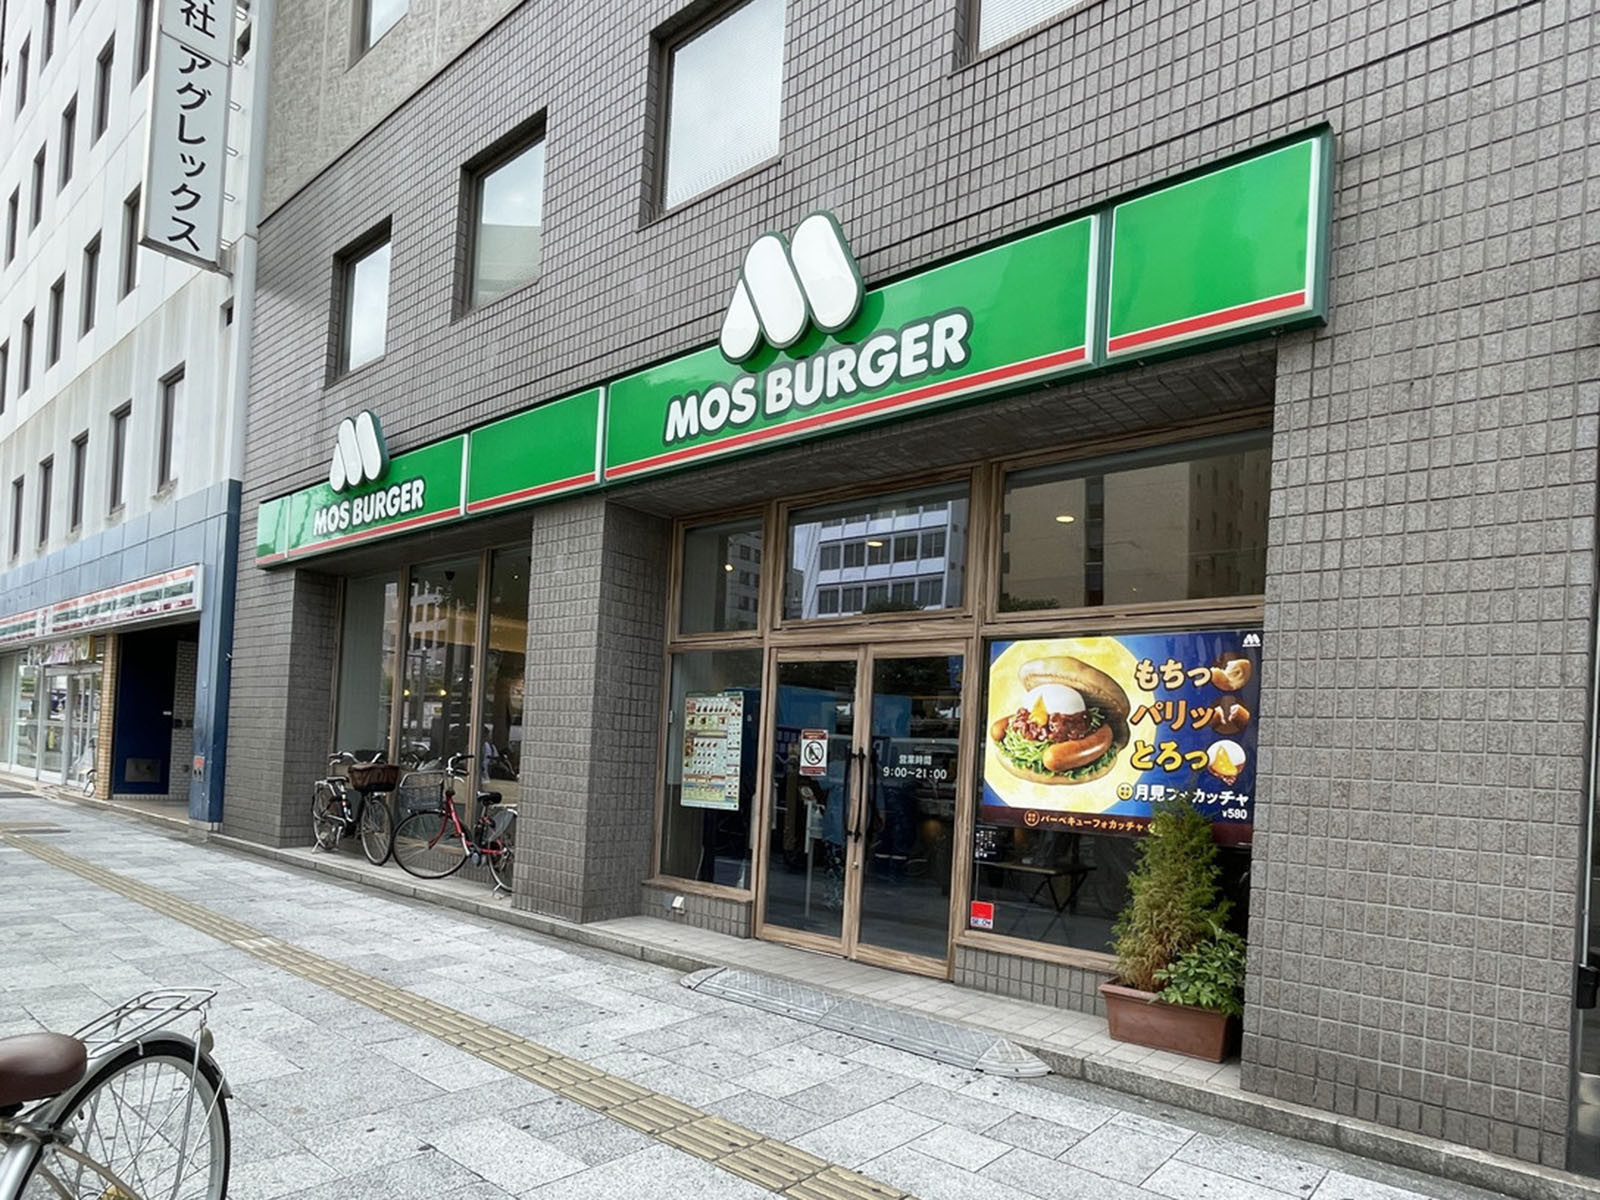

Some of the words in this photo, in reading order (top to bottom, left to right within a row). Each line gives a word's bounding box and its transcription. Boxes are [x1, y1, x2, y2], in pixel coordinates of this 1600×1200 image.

[167, 0, 217, 252] 社アグレックス
[664, 375, 758, 443] MOS
[764, 312, 968, 415] BURGER
[313, 500, 350, 537] MOS
[352, 478, 425, 526] BURGER
[1135, 658, 1212, 690] もちっ
[1130, 699, 1214, 730] パリッ
[1130, 740, 1209, 771] とろっ
[1134, 783, 1249, 807] 月見フカッチャ
